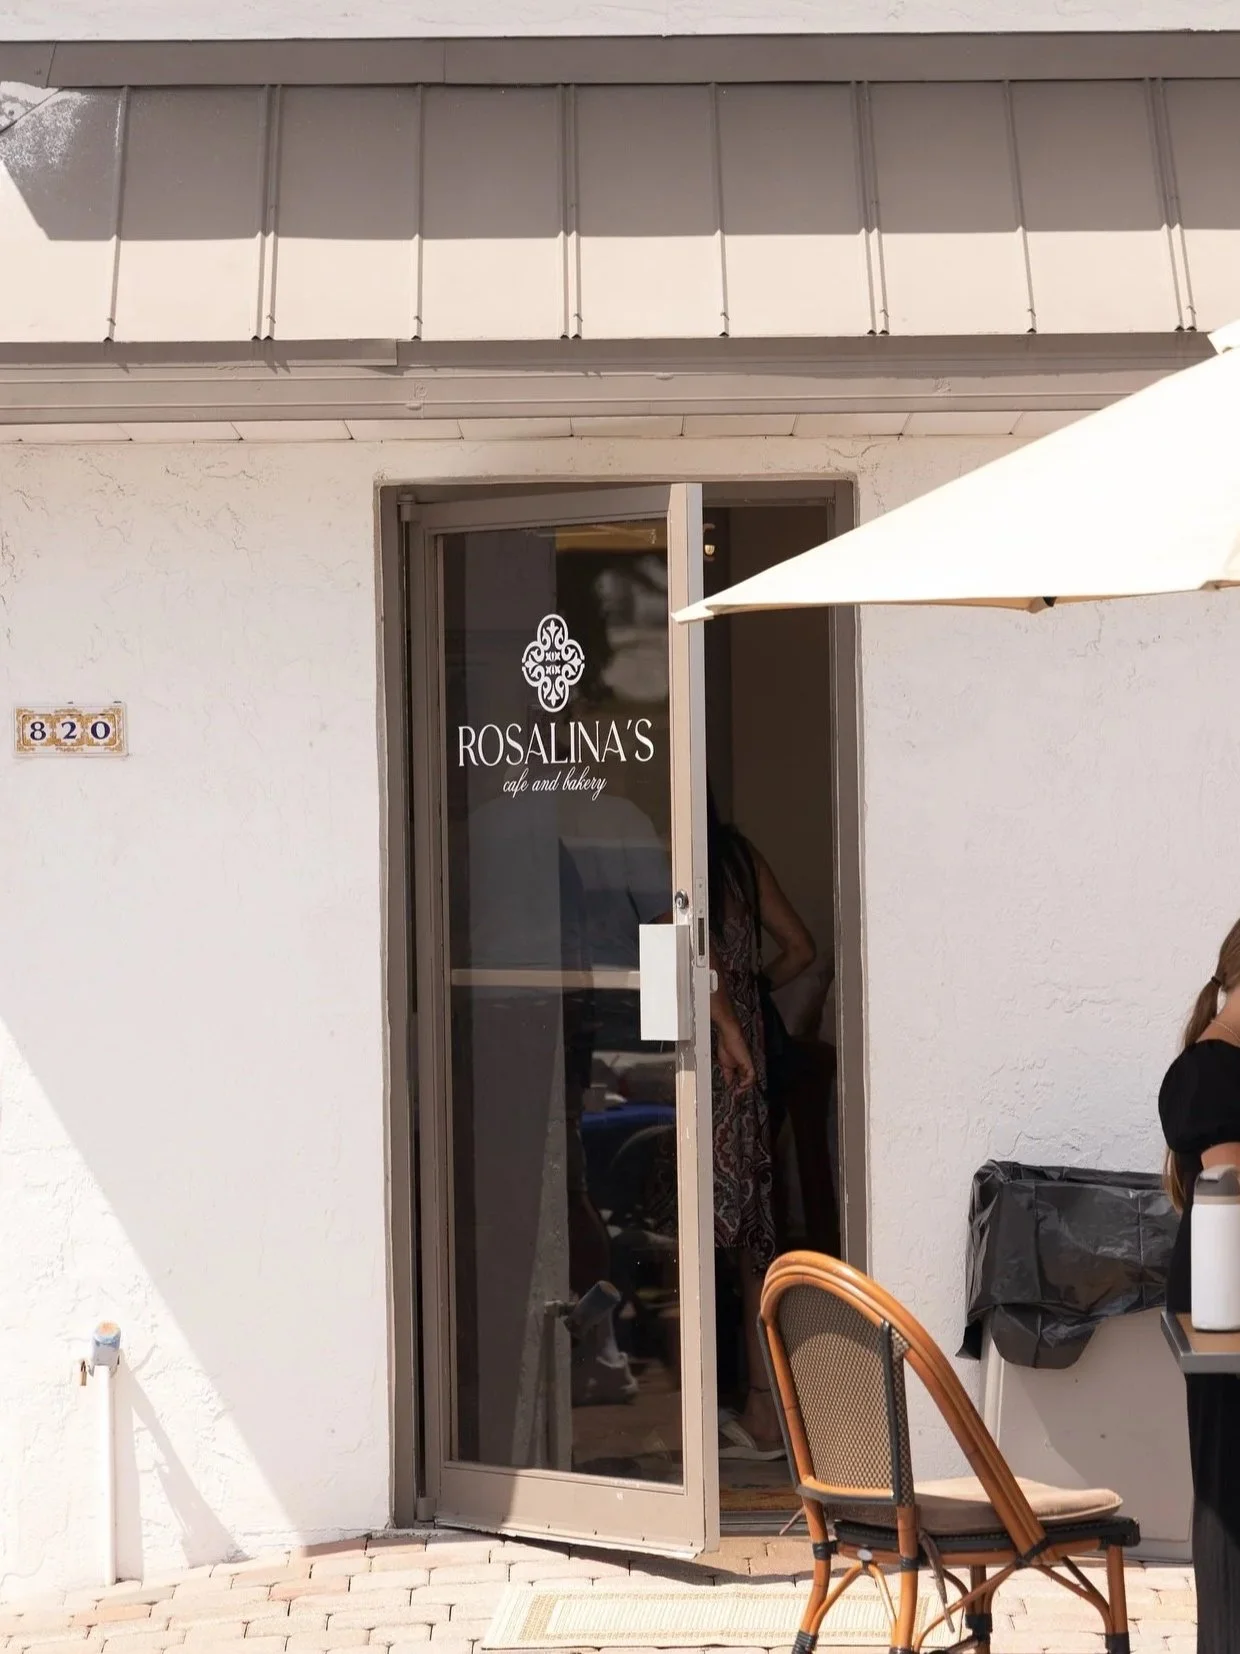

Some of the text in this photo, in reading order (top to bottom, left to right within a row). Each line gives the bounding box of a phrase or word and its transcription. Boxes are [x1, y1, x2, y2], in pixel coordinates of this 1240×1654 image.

[29, 720, 111, 741] 820
[458, 718, 655, 767] ROSALINA'S
[502, 765, 607, 801] cafe and bakery
